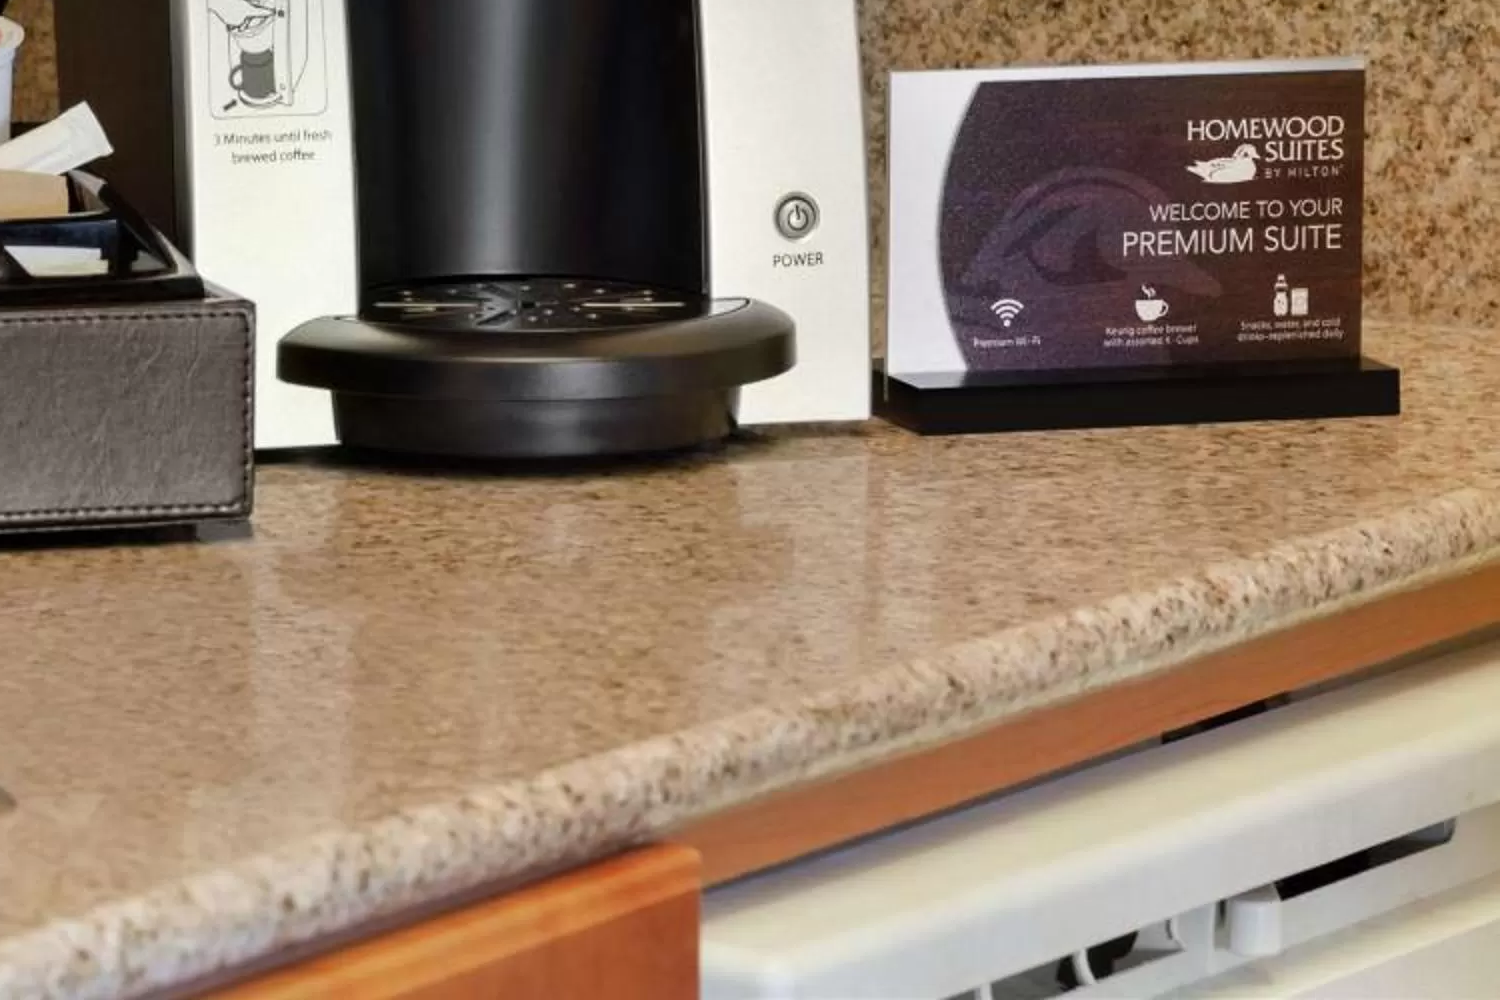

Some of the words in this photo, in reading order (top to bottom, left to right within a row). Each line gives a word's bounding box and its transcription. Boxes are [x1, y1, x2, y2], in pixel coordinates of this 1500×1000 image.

[273, 128, 301, 143] until
[302, 127, 333, 142] fresh
[1187, 115, 1345, 142] HOMEWOOD
[231, 149, 277, 164] brewed
[279, 147, 316, 162] coffee
[1264, 139, 1345, 162] SUITES
[1264, 169, 1281, 179] BY
[1149, 201, 1251, 222] WELCOME
[1257, 200, 1284, 218] TO
[1289, 197, 1343, 217] YOUR
[1123, 228, 1254, 257] PREMIUM
[1263, 223, 1343, 253] SUITE
[772, 251, 824, 268] POWER
